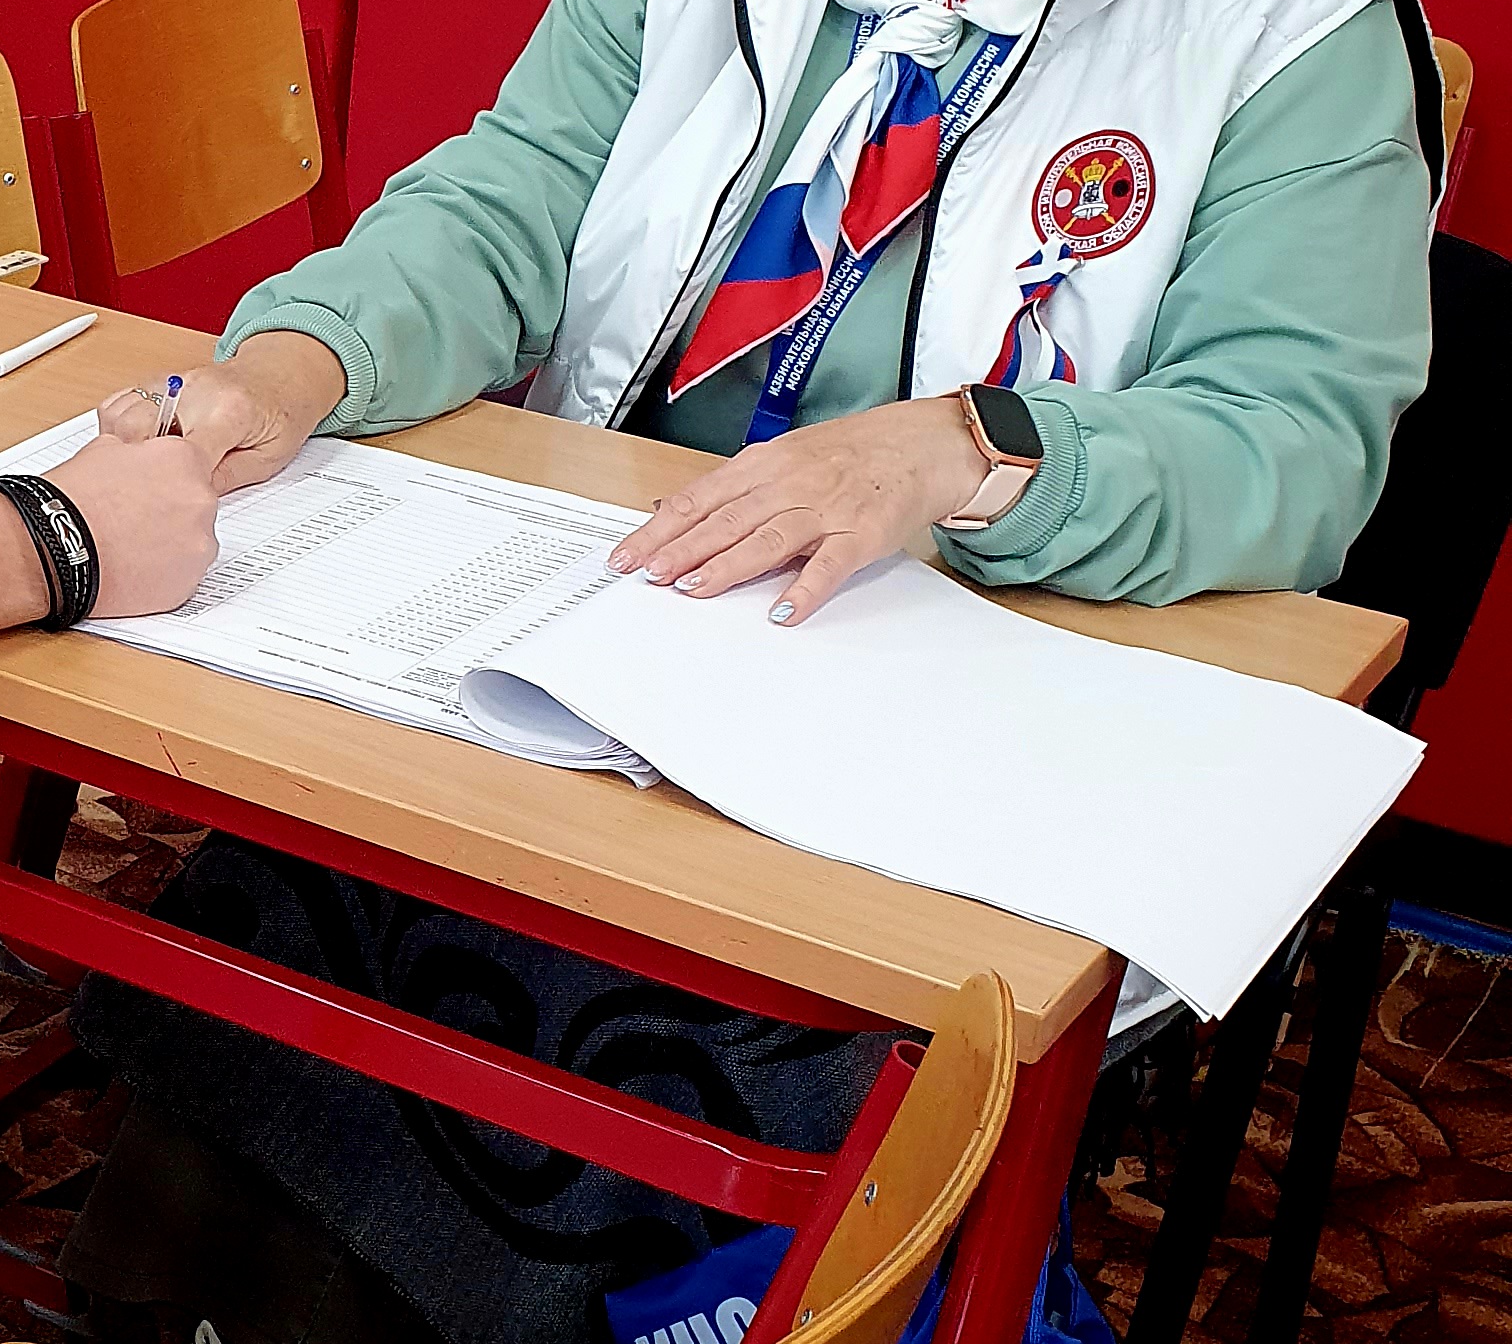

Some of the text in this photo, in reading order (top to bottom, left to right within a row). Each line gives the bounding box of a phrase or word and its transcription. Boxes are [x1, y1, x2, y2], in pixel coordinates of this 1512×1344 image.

[951, 43, 1000, 106] КОМИССИЯ
[768, 252, 859, 396] ИЗБИРАТЕЛЬНАЯ КОМИССИ
[786, 268, 864, 391] МОСКОВСКОЙ ОБЛАСТИ
